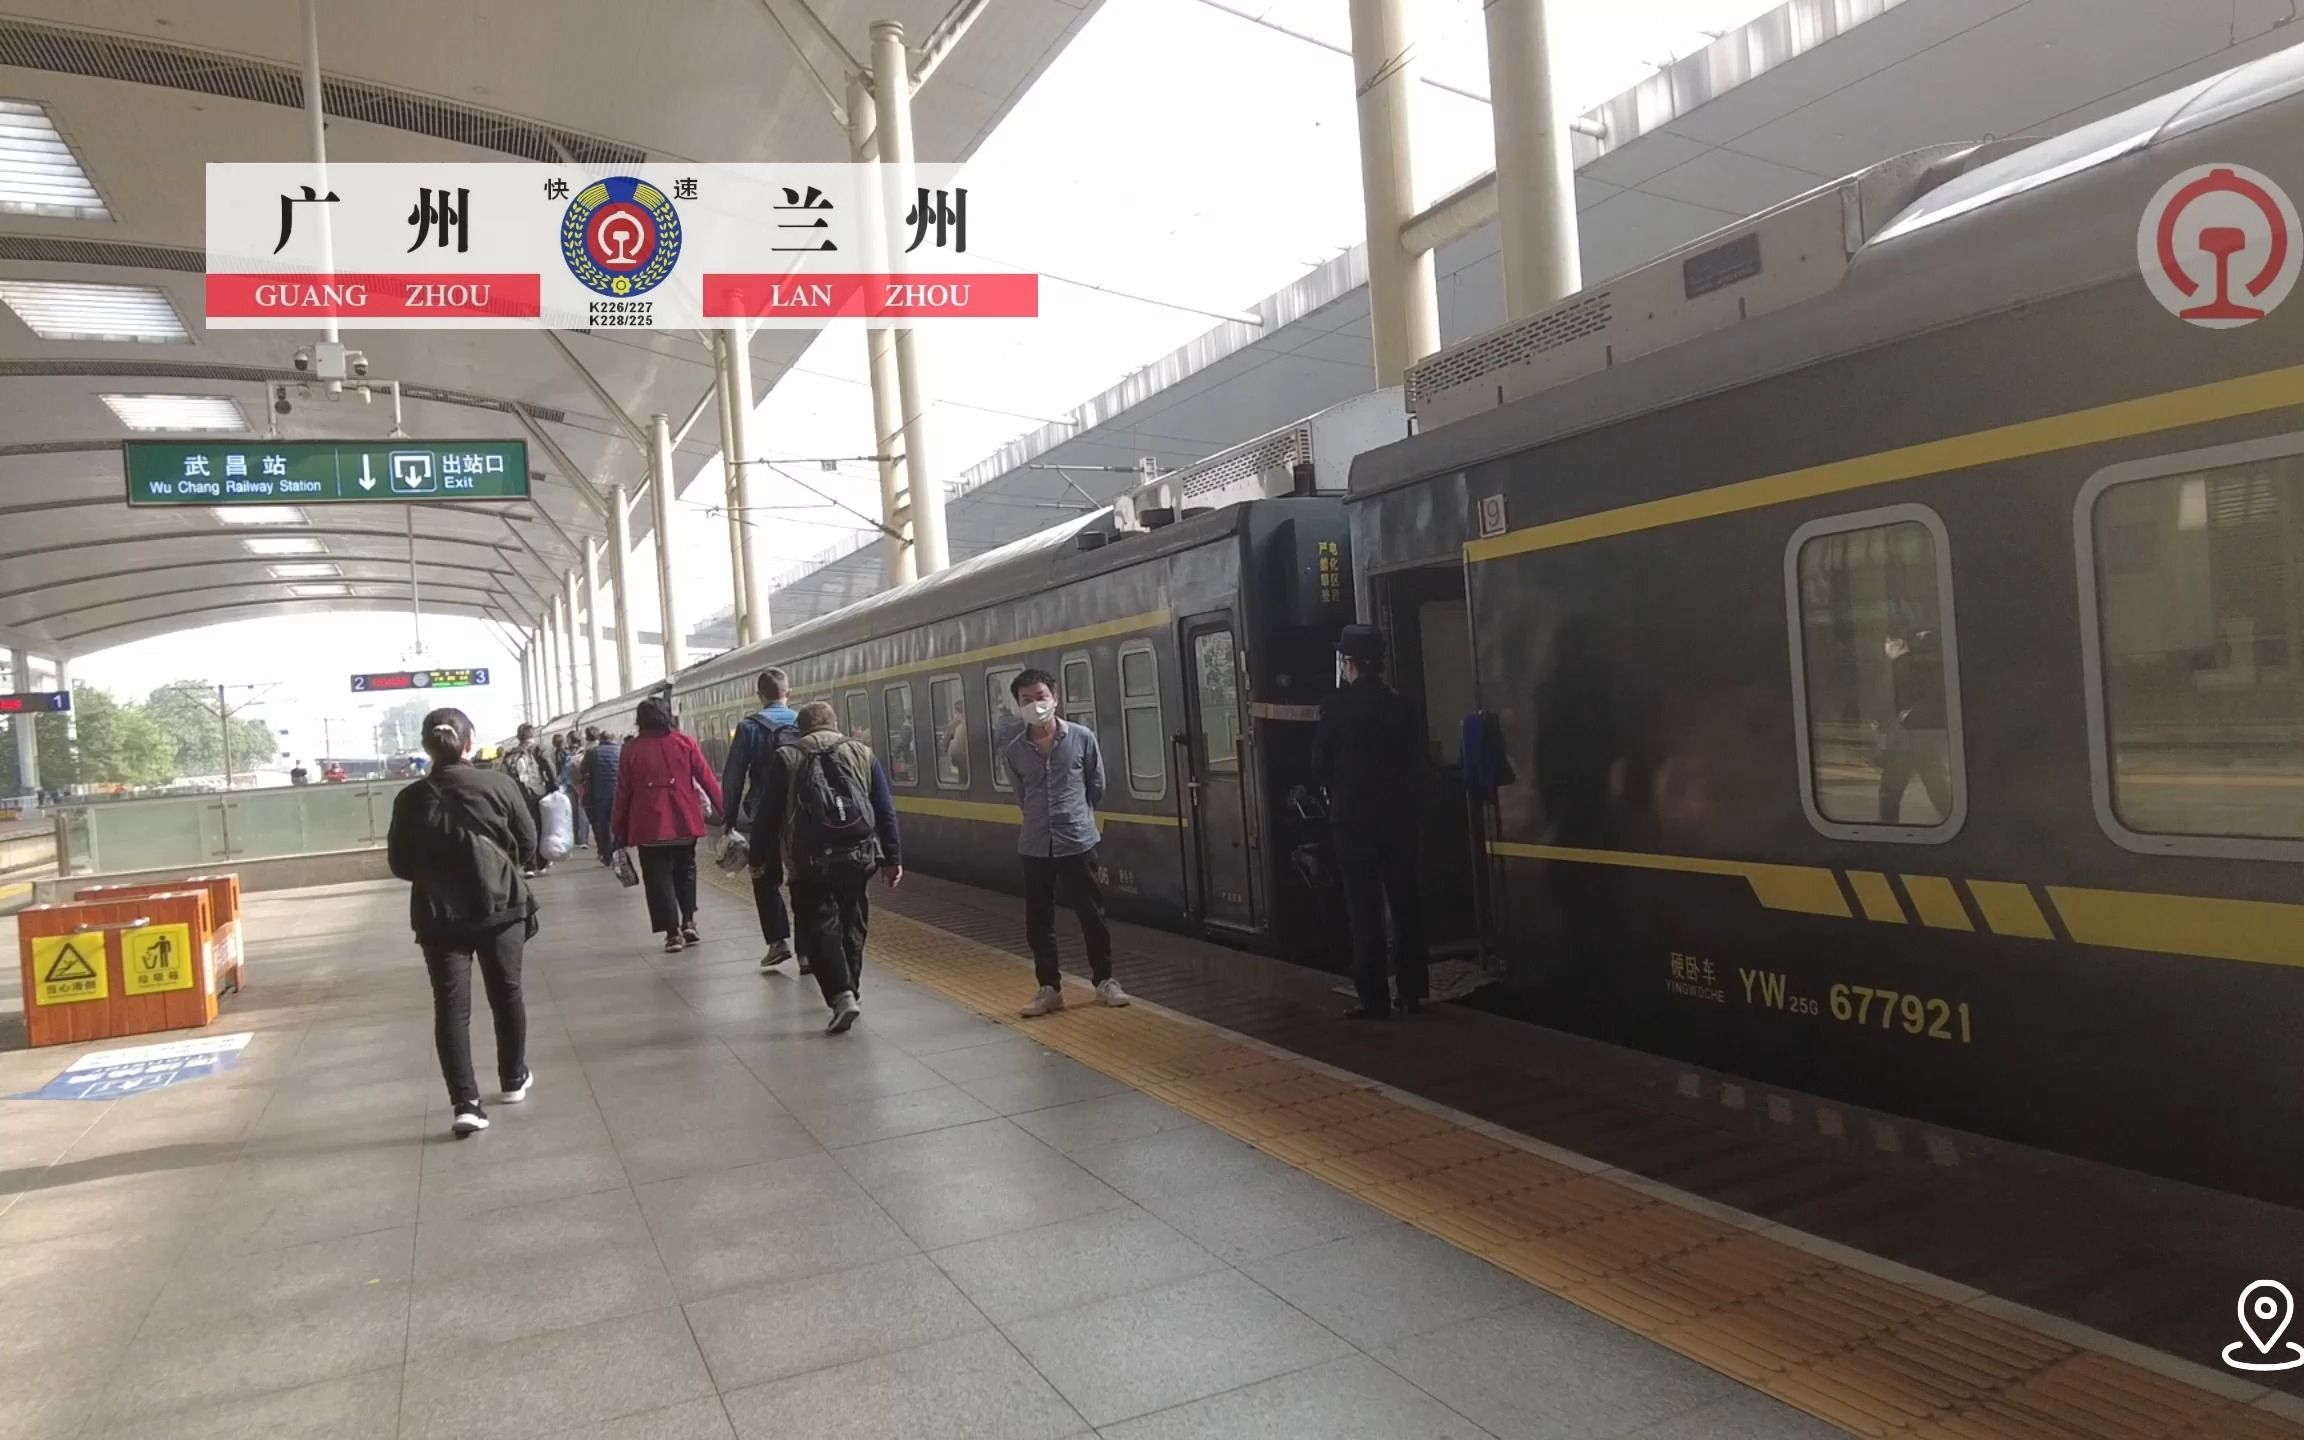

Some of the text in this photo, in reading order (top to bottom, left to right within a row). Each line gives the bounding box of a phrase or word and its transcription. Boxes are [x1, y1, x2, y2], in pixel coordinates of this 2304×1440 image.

[184, 454, 287, 477] 武昌站
[442, 453, 505, 475] 出站口
[150, 479, 321, 496] Wu Chang Railway Station
[444, 476, 474, 489] Exit
[1487, 499, 1500, 527] 9
[353, 676, 366, 691] 2
[475, 670, 487, 684] 3
[53, 694, 63, 709] 1
[1738, 967, 1972, 1044] YW 25G 677921
